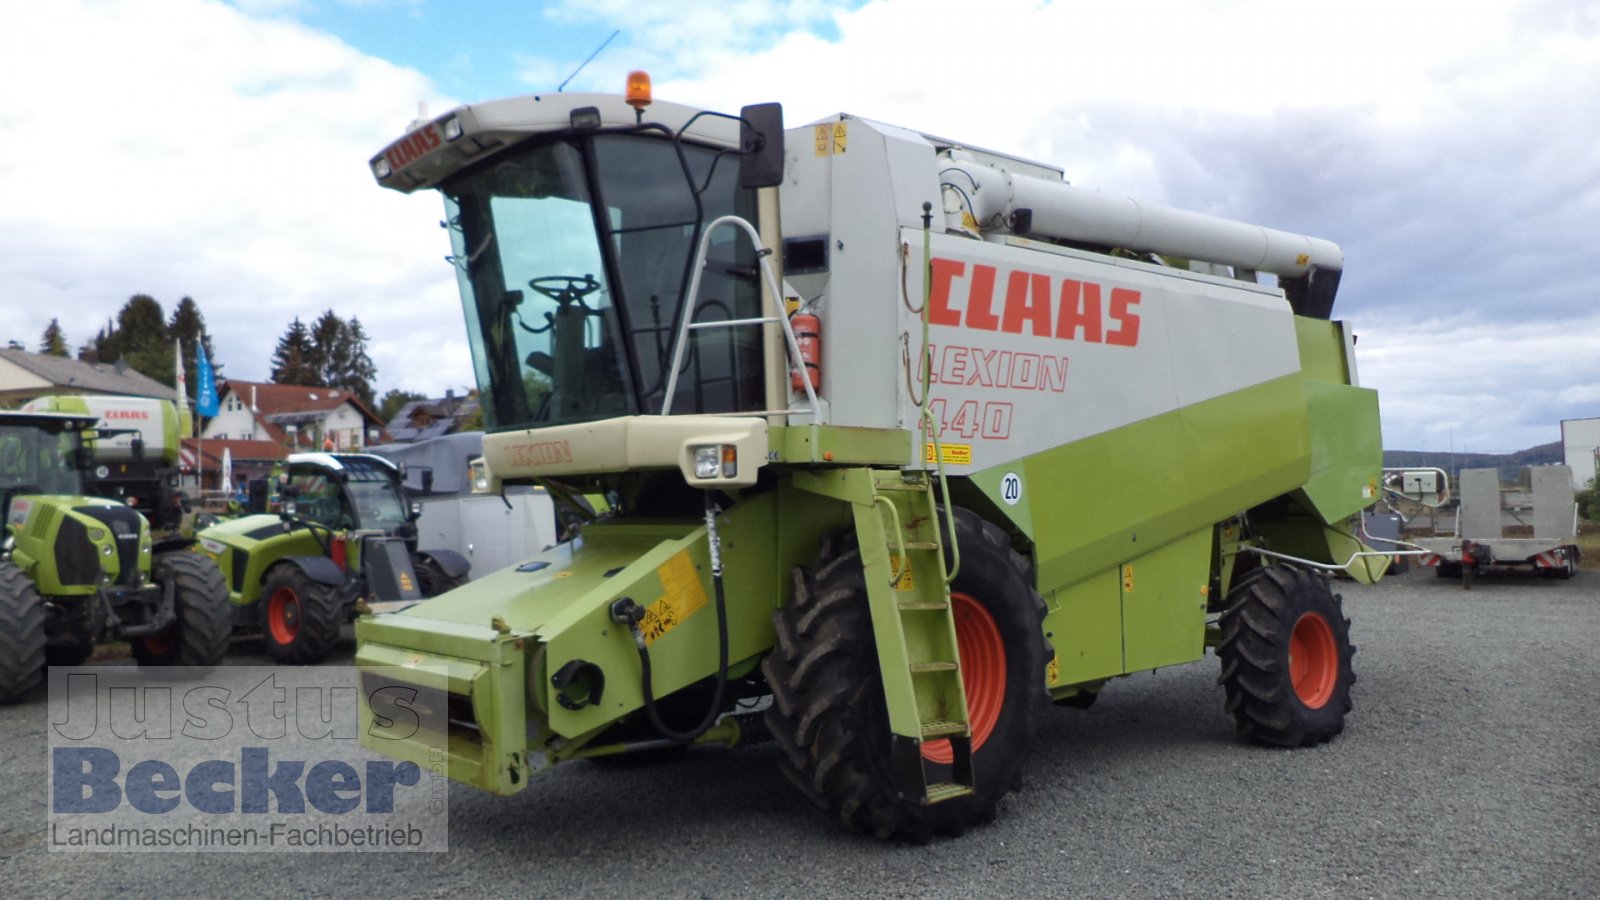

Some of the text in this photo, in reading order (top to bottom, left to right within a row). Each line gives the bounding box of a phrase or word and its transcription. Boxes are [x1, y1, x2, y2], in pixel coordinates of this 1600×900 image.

[385, 124, 441, 171] CLAAS
[921, 257, 1141, 347] CLAAS
[917, 344, 1069, 392] LEXION
[105, 410, 149, 419] CLAAS
[918, 398, 1013, 439] 440
[504, 440, 573, 467] LEXION
[1005, 478, 1018, 499] 20
